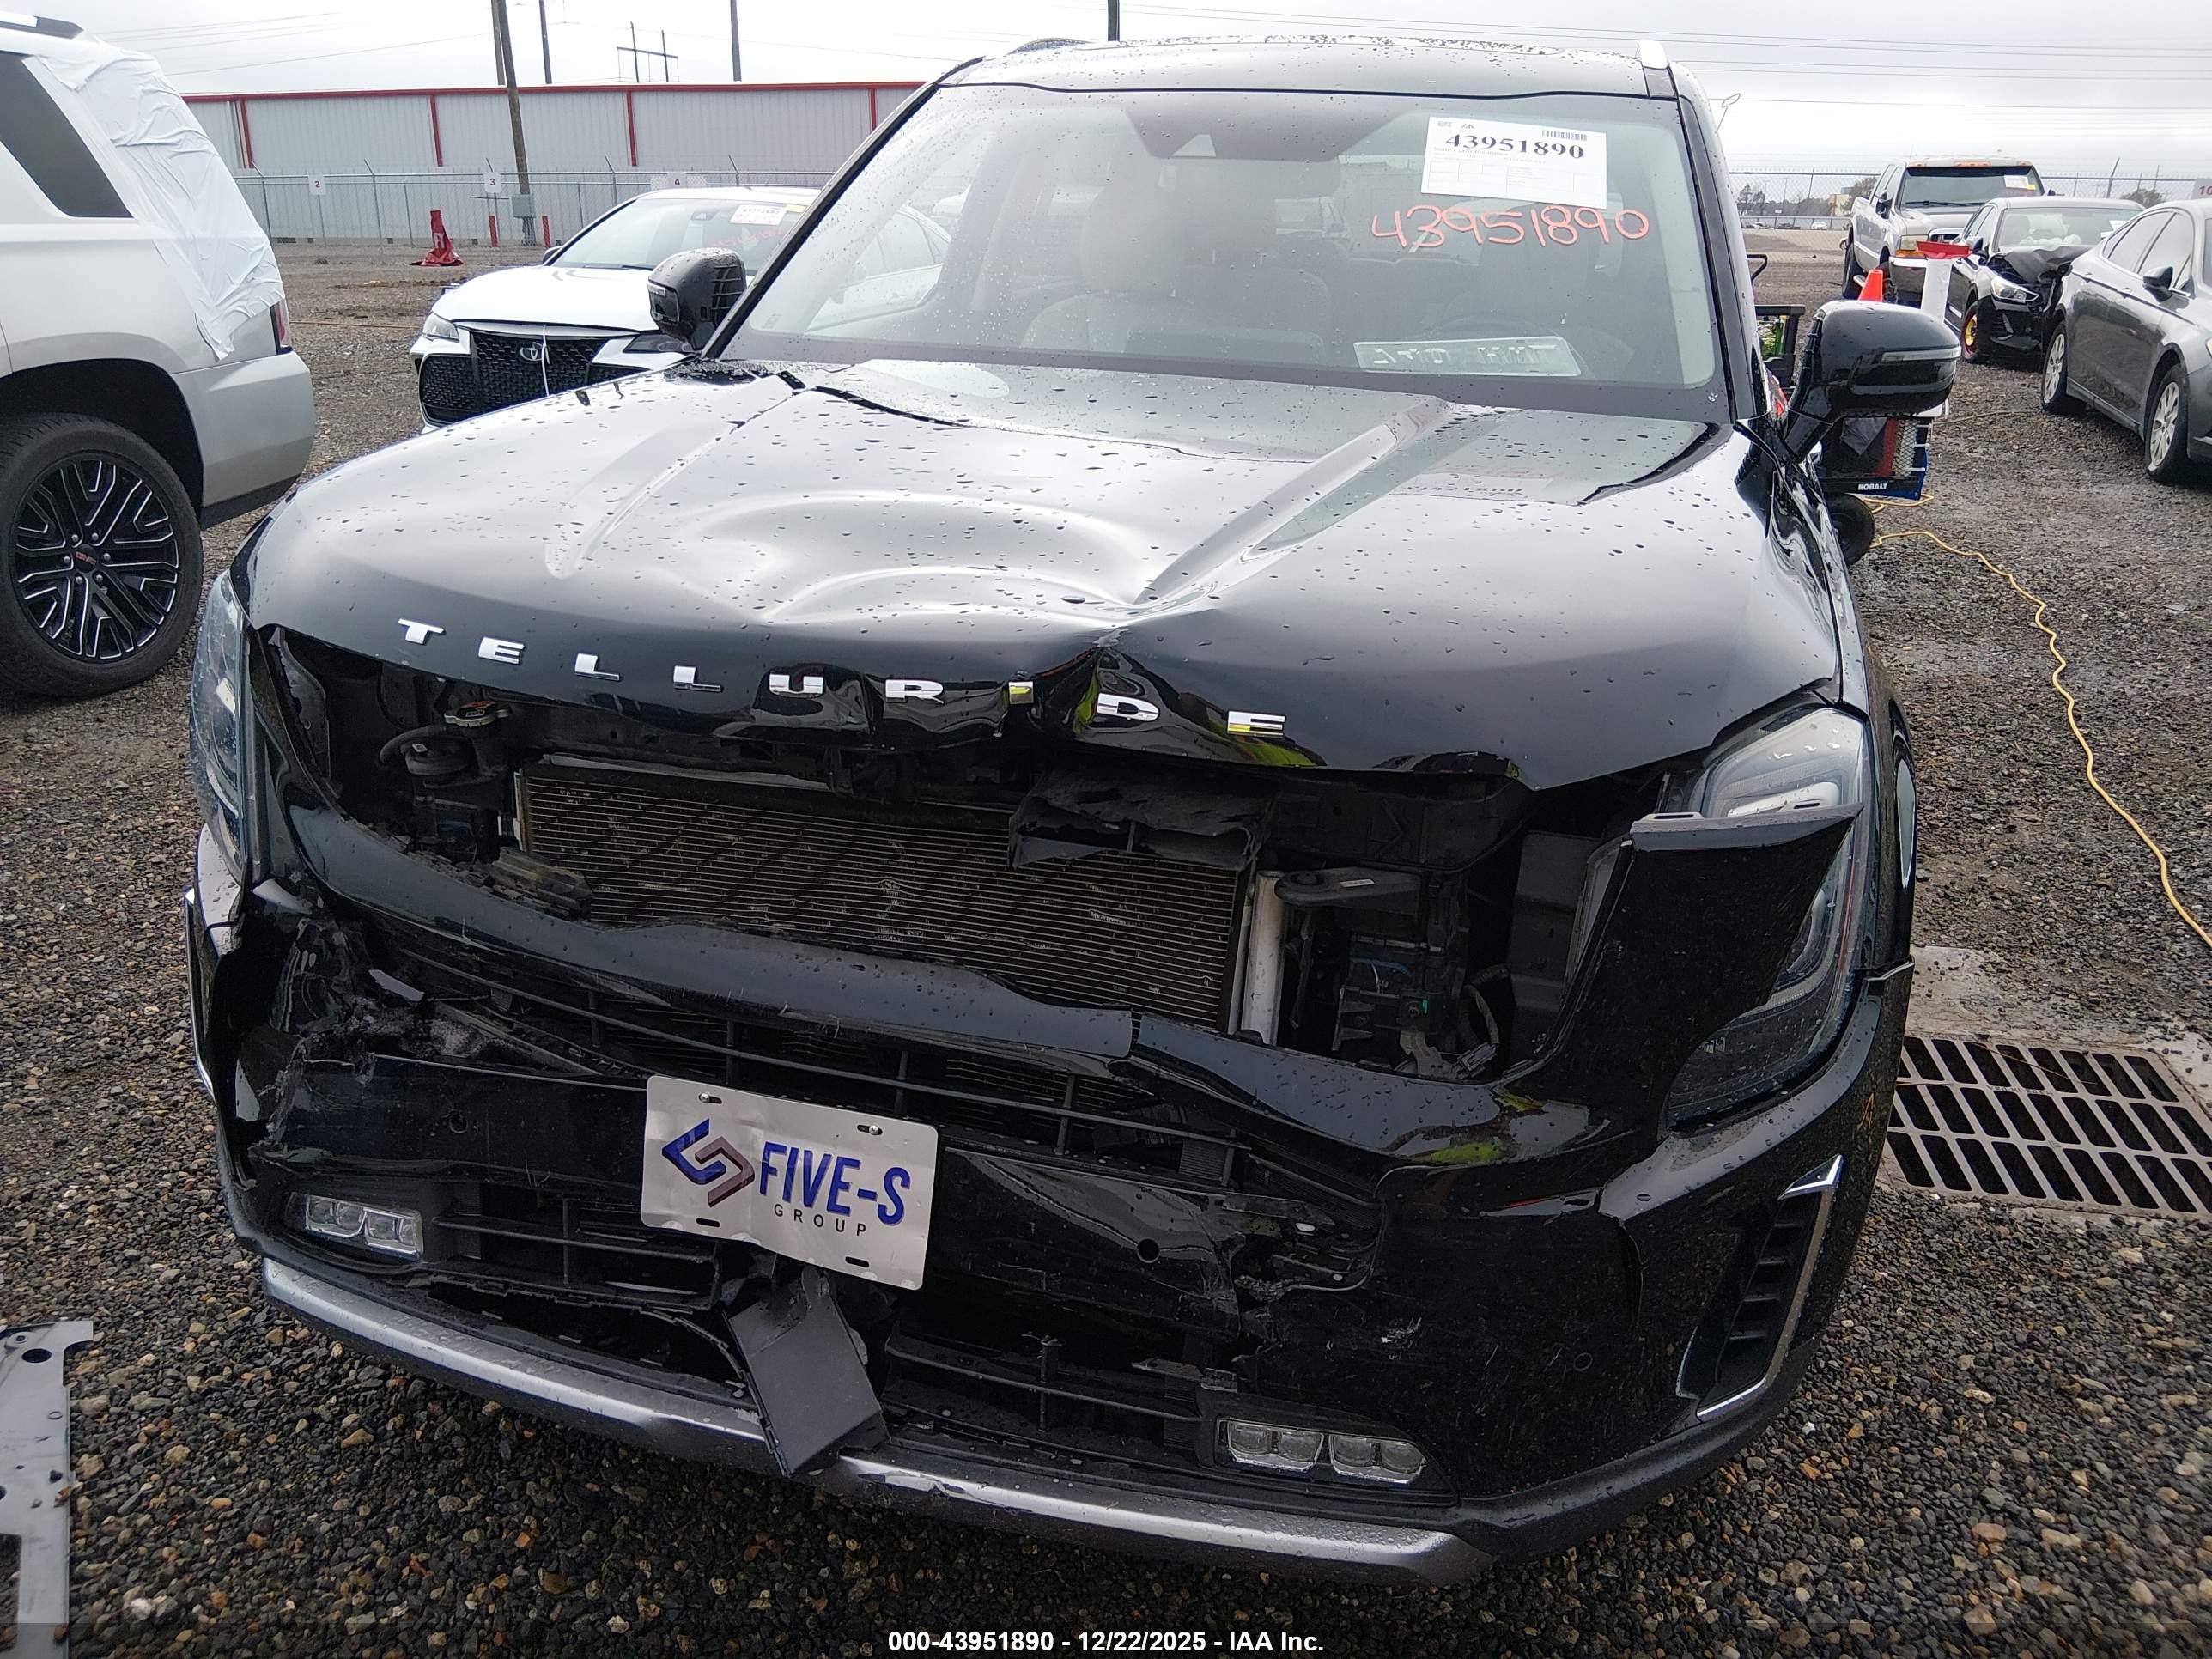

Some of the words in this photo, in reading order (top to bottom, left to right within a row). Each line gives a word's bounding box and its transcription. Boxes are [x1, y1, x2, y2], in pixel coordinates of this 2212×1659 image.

[1446, 134, 1584, 159] 43951890
[489, 178, 495, 186] 3
[674, 178, 680, 186] 4
[1371, 205, 1650, 247] 43951890
[1857, 483, 1888, 491] KOBALT
[398, 617, 1286, 737] TELLURIDE
[759, 1140, 911, 1226] FIVE-S
[774, 1204, 866, 1237] GROUP
